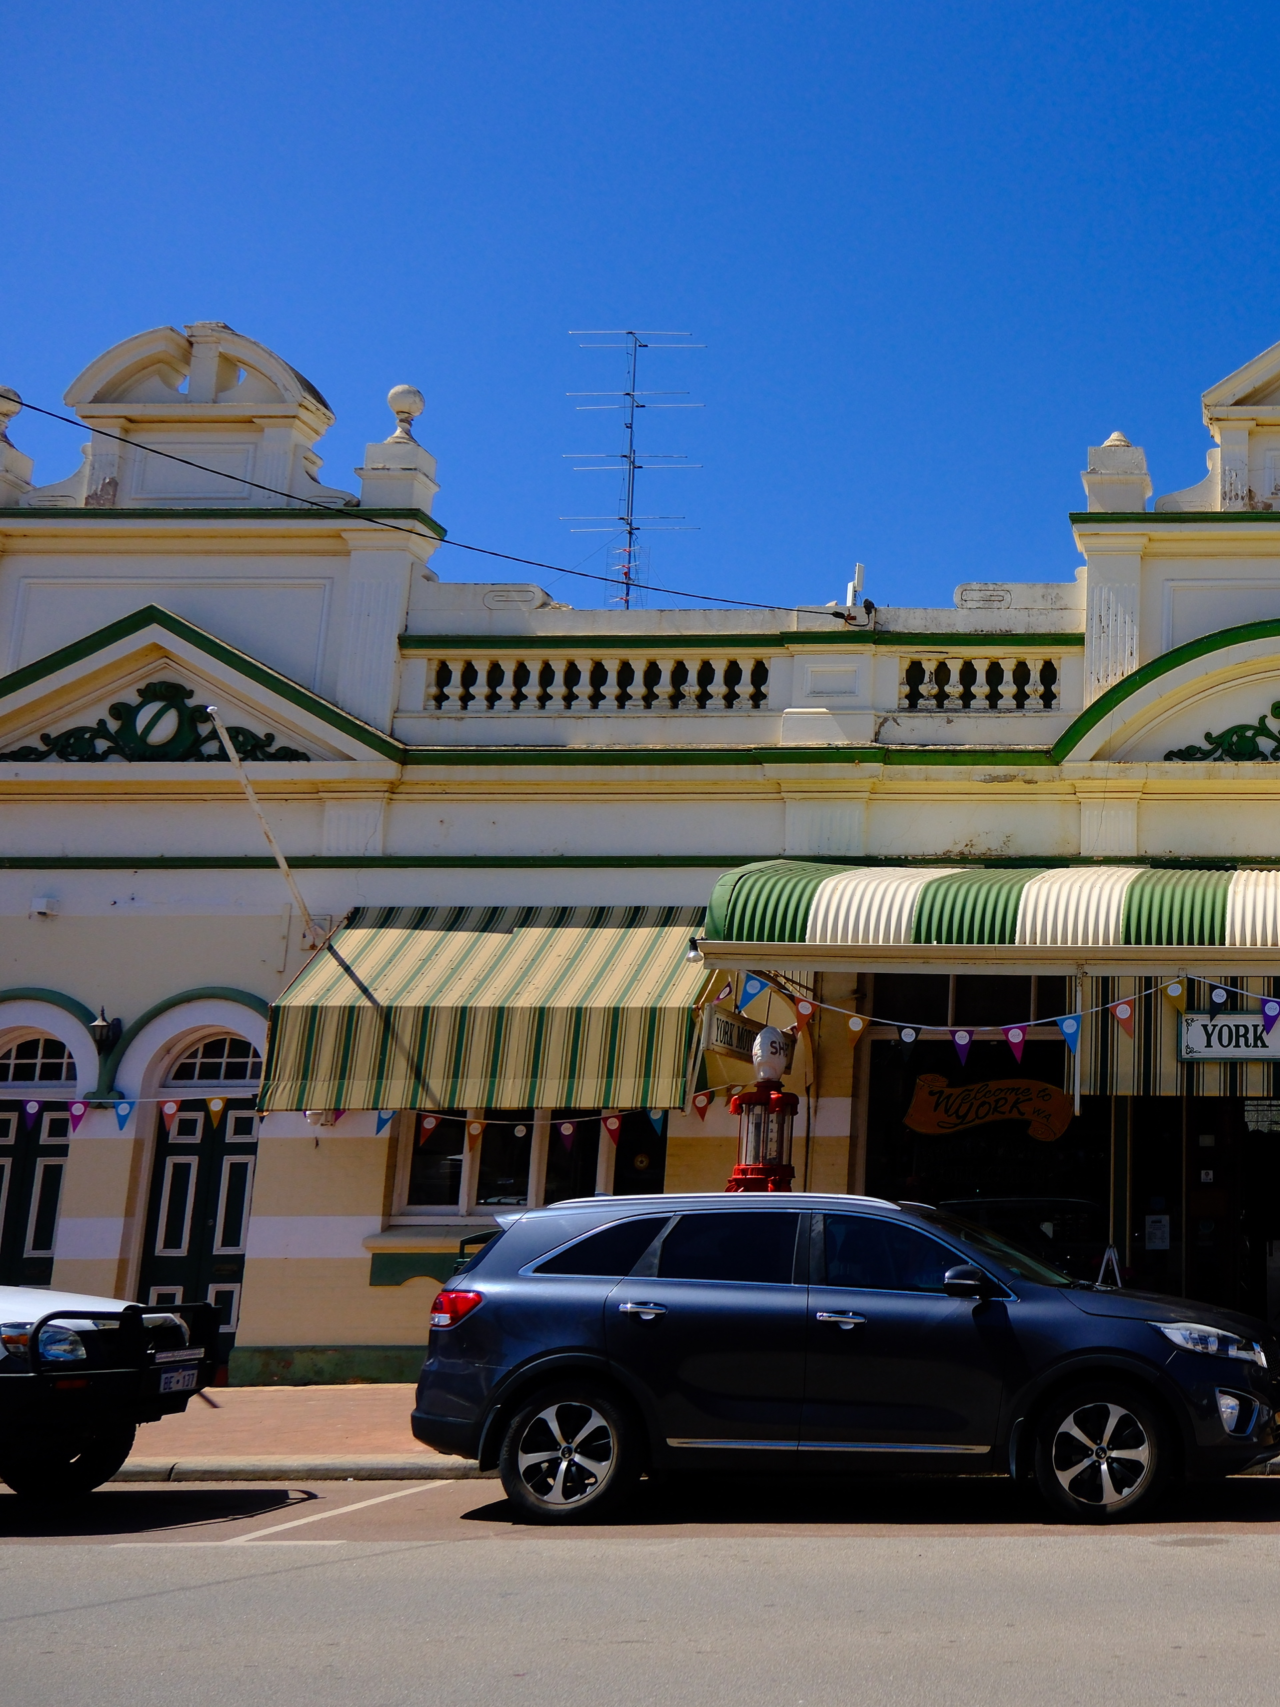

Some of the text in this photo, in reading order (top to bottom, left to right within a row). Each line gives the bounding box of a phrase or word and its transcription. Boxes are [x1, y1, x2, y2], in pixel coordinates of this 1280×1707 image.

[715, 1017, 736, 1048] YORK
[1201, 1024, 1269, 1049] YORK
[928, 1083, 1052, 1118] Welcome to
[1033, 1106, 1052, 1122] WA
